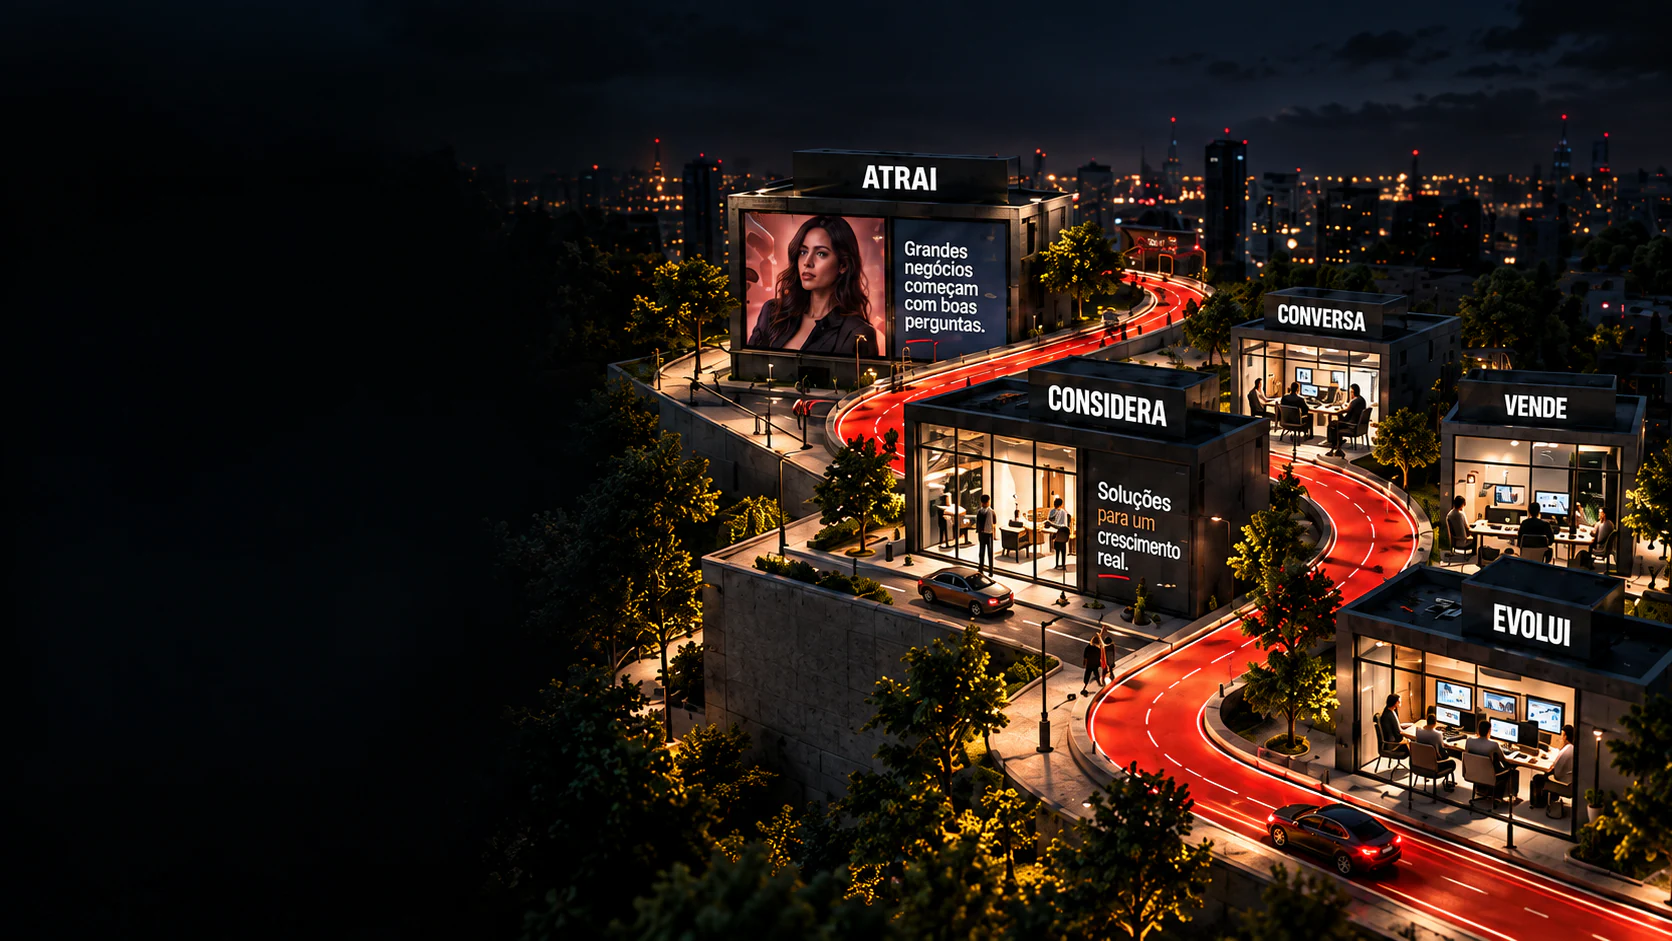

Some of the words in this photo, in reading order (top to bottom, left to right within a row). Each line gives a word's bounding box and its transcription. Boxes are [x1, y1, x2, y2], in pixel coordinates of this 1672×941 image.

[862, 165, 937, 191] ATRAI
[904, 240, 968, 259] Grandes
[904, 259, 973, 279] negócios
[904, 280, 978, 299] começam
[904, 298, 937, 312] com
[941, 296, 978, 315] boas
[905, 316, 986, 334] perguntas.
[1277, 304, 1366, 332] CONVERSA
[1048, 384, 1167, 427] CONSIDERA
[1504, 394, 1568, 419] VENDE
[1097, 481, 1172, 512] Soluções
[1097, 508, 1129, 527] para
[1132, 515, 1155, 532] um
[1097, 530, 1181, 560] crescimento
[1097, 551, 1129, 571] real.
[1493, 603, 1571, 647] EVOLUI
